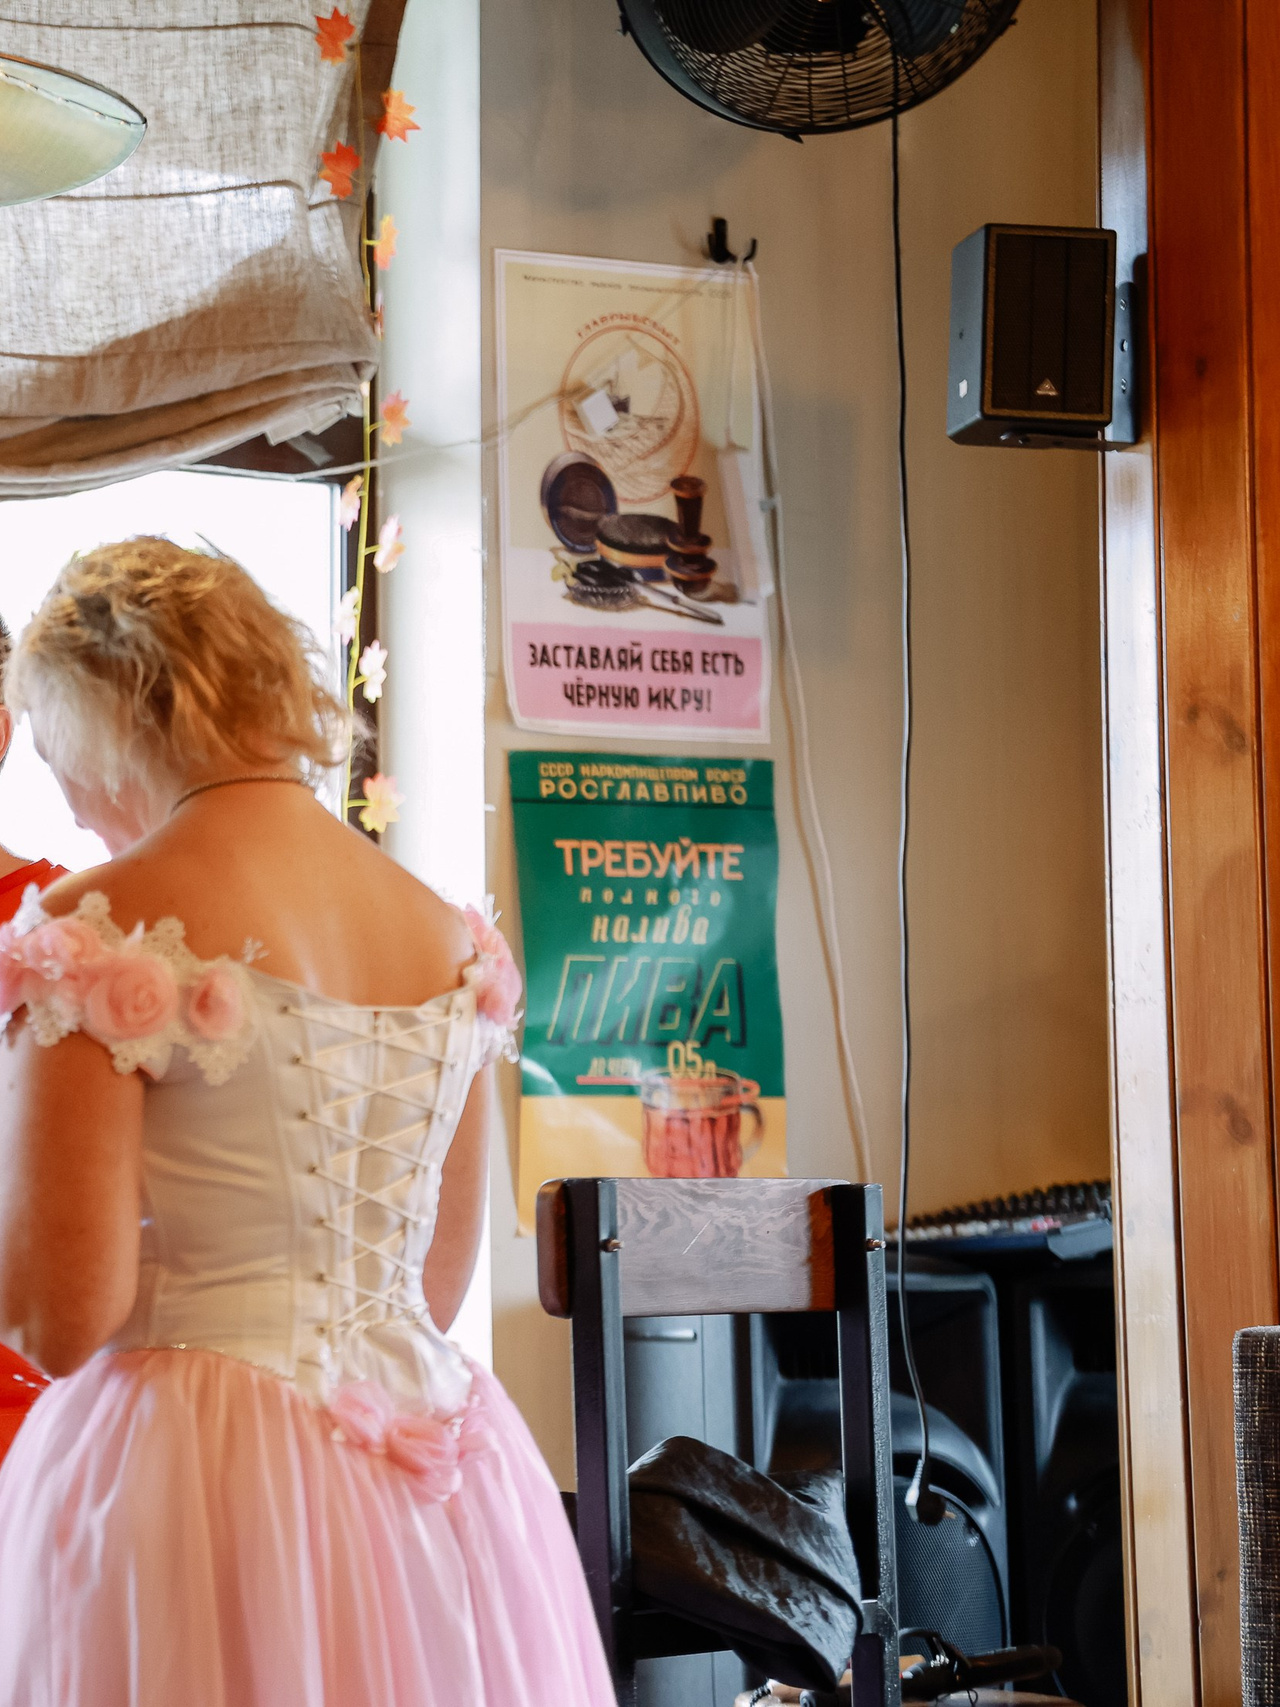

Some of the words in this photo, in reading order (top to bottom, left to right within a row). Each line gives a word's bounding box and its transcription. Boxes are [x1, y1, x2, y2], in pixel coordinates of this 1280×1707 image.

[529, 641, 643, 672] ЗАСТАВЛЯЙ
[651, 648, 693, 674] СЕБЯ
[702, 652, 745, 677] ЕСТЬ
[563, 676, 640, 709] ЧЁРНУЮ
[647, 684, 712, 713] ИКРУ!
[540, 778, 748, 805] РОСГЛАВПИВО
[554, 837, 745, 880] ТРЕБУЙТЕ
[547, 954, 747, 1047] ПИВА
